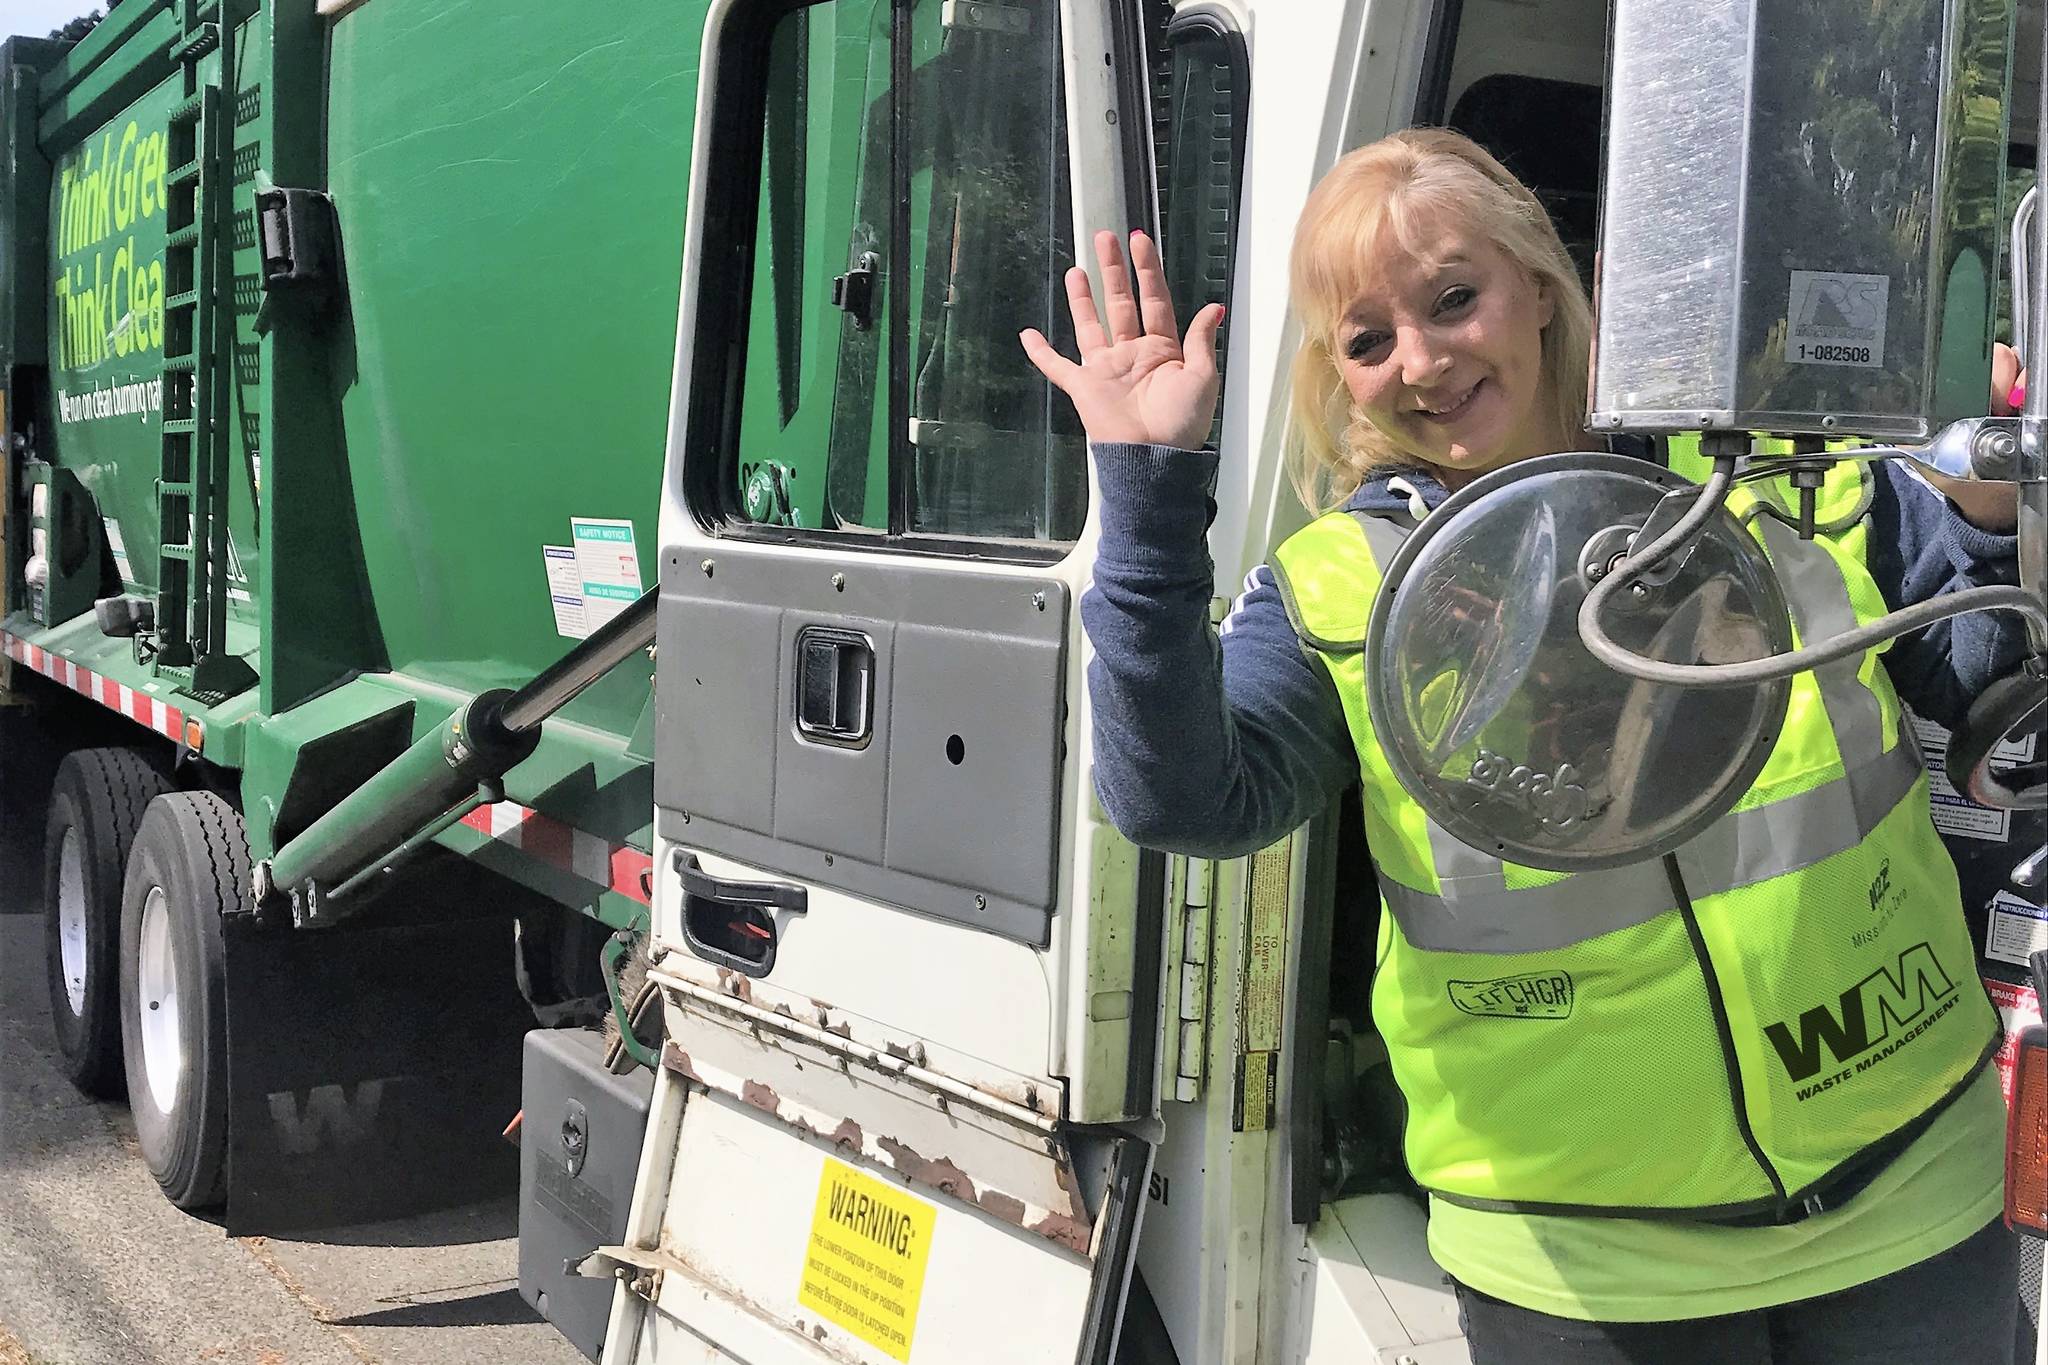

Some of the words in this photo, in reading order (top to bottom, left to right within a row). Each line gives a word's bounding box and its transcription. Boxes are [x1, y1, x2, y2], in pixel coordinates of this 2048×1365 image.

[59, 133, 114, 259] Think
[56, 253, 110, 371] Think
[1798, 344, 1870, 363] 1-082508
[82, 392, 93, 420] on
[93, 379, 114, 419] clean
[112, 374, 147, 424] burning
[579, 527, 601, 538] SAFETY
[602, 529, 626, 540] NOTICE
[1254, 935, 1262, 956] CAB
[1261, 935, 1270, 970] LOWER
[1270, 935, 1278, 949] TO
[1763, 942, 1956, 1083] WM
[1991, 988, 2015, 1002] BRAKE
[1796, 1066, 1853, 1102] WASTE
[1856, 994, 1961, 1073] MANAGEMENT
[829, 1180, 916, 1260] WARNING:
[808, 1257, 824, 1273] MUST
[824, 1265, 831, 1278] BE
[831, 1269, 852, 1289] LOCKED
[853, 1279, 859, 1293] IN
[860, 1283, 871, 1300] THE
[870, 1290, 879, 1303] UP
[879, 1295, 906, 1319] POSITION
[813, 1232, 824, 1247] THE
[824, 1240, 842, 1257] LOWER
[842, 1248, 866, 1269] PORTION
[866, 1260, 874, 1273] OF
[875, 1264, 888, 1281] THIS
[888, 1272, 904, 1290] DOOR
[804, 1281, 825, 1301] BEFORE
[824, 1290, 843, 1311] ENTIRE
[842, 1302, 859, 1320] DOOR
[865, 1315, 890, 1338] LATCHED
